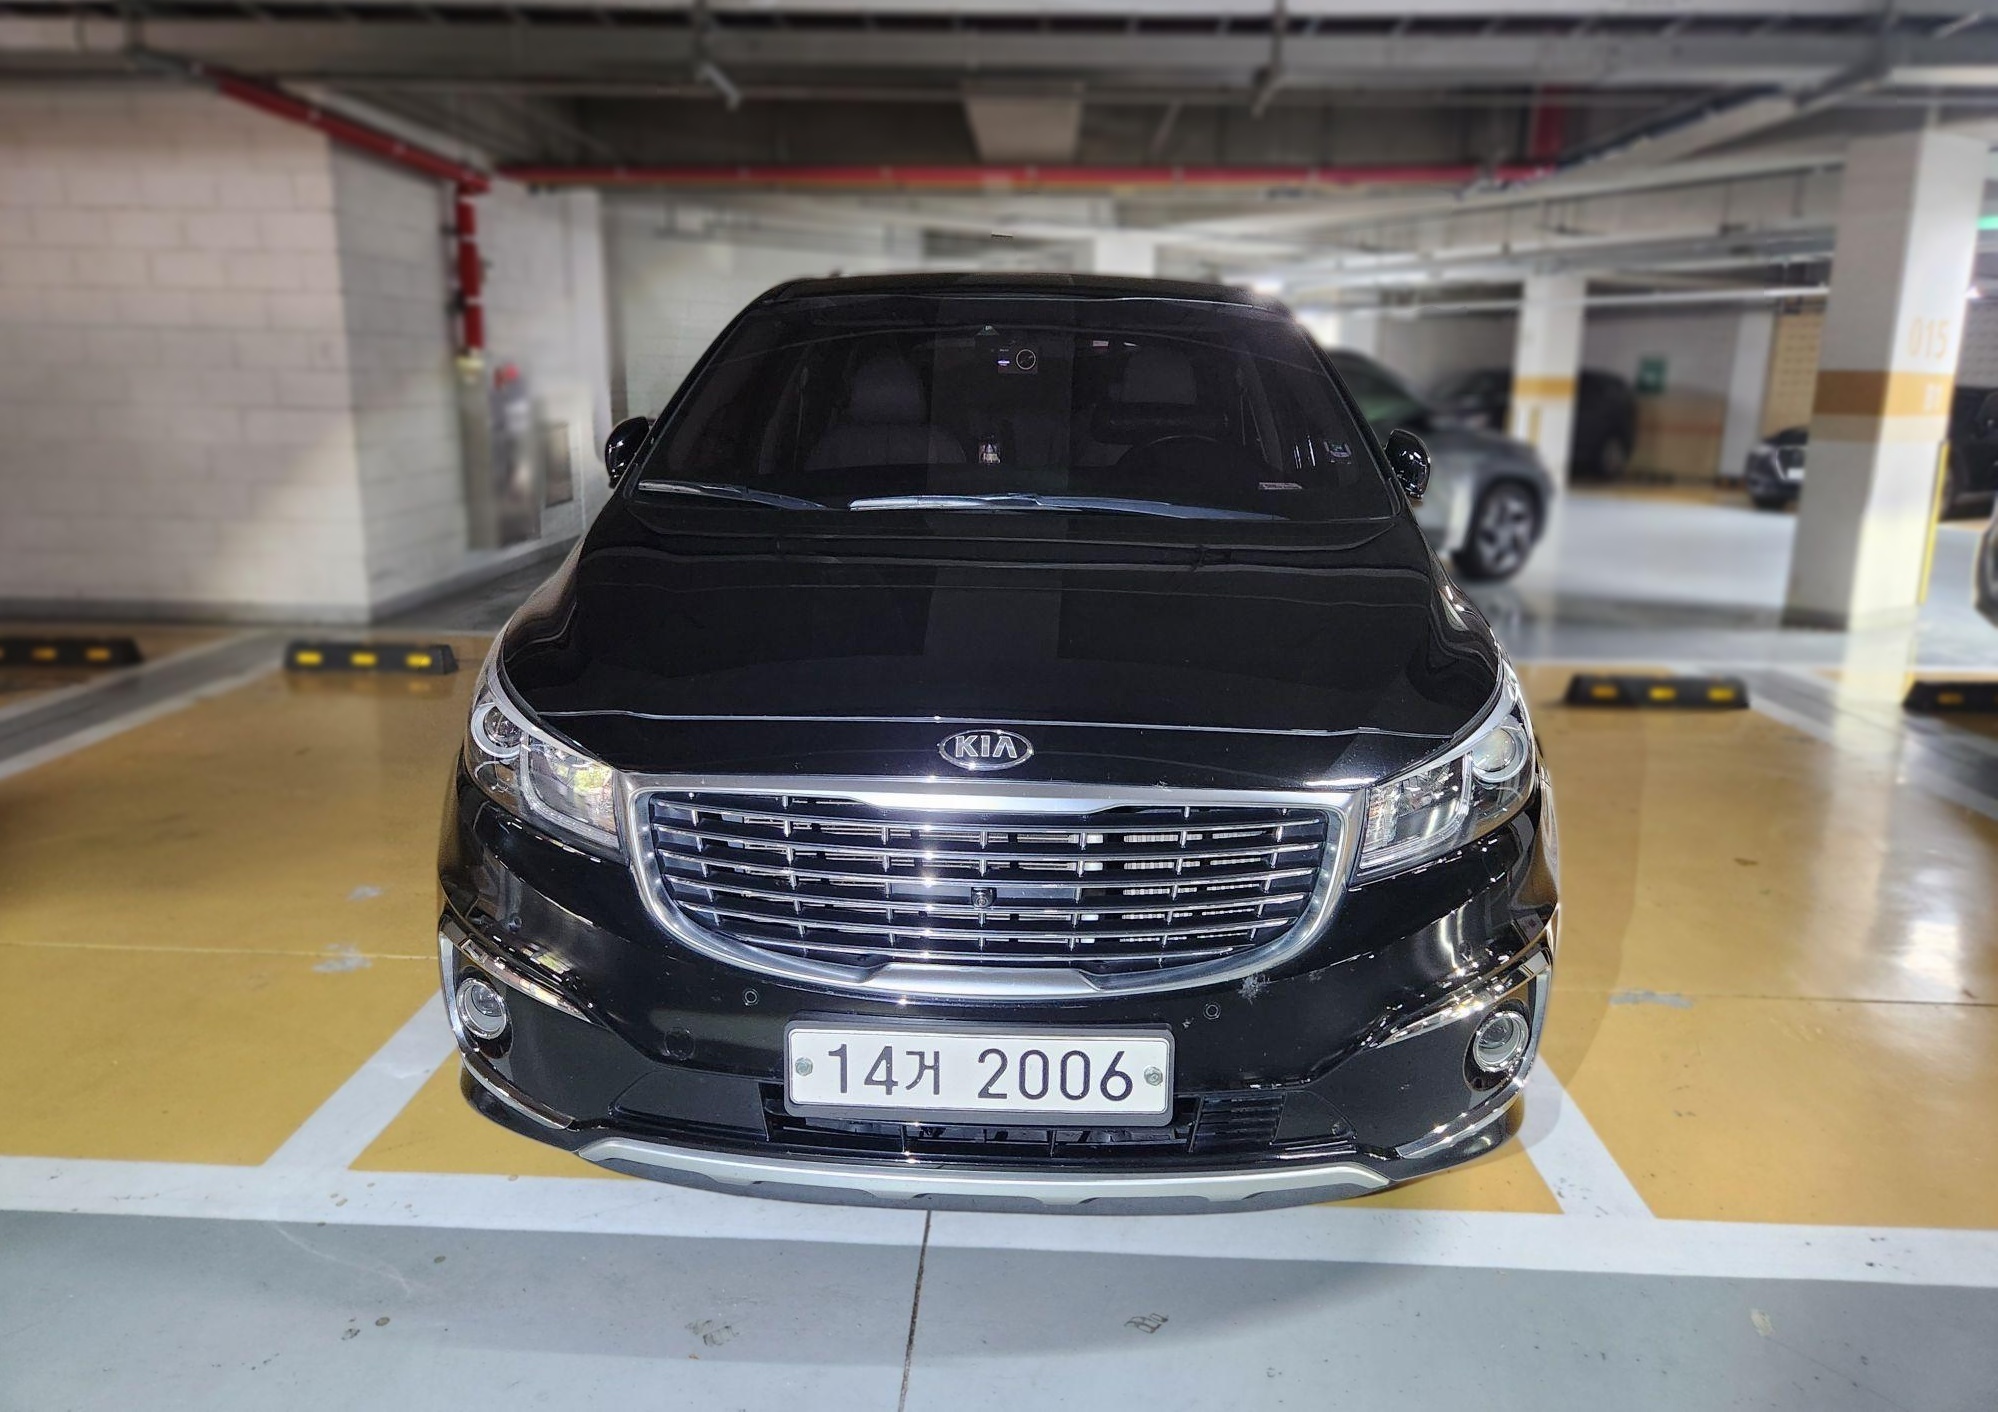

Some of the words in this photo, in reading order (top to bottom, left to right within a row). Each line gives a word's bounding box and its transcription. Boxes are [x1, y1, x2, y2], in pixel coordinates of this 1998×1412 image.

[1908, 317, 1950, 358] 015
[955, 735, 1018, 758] KIA
[828, 1043, 940, 1095] 14거
[977, 1048, 1133, 1101] 2006
